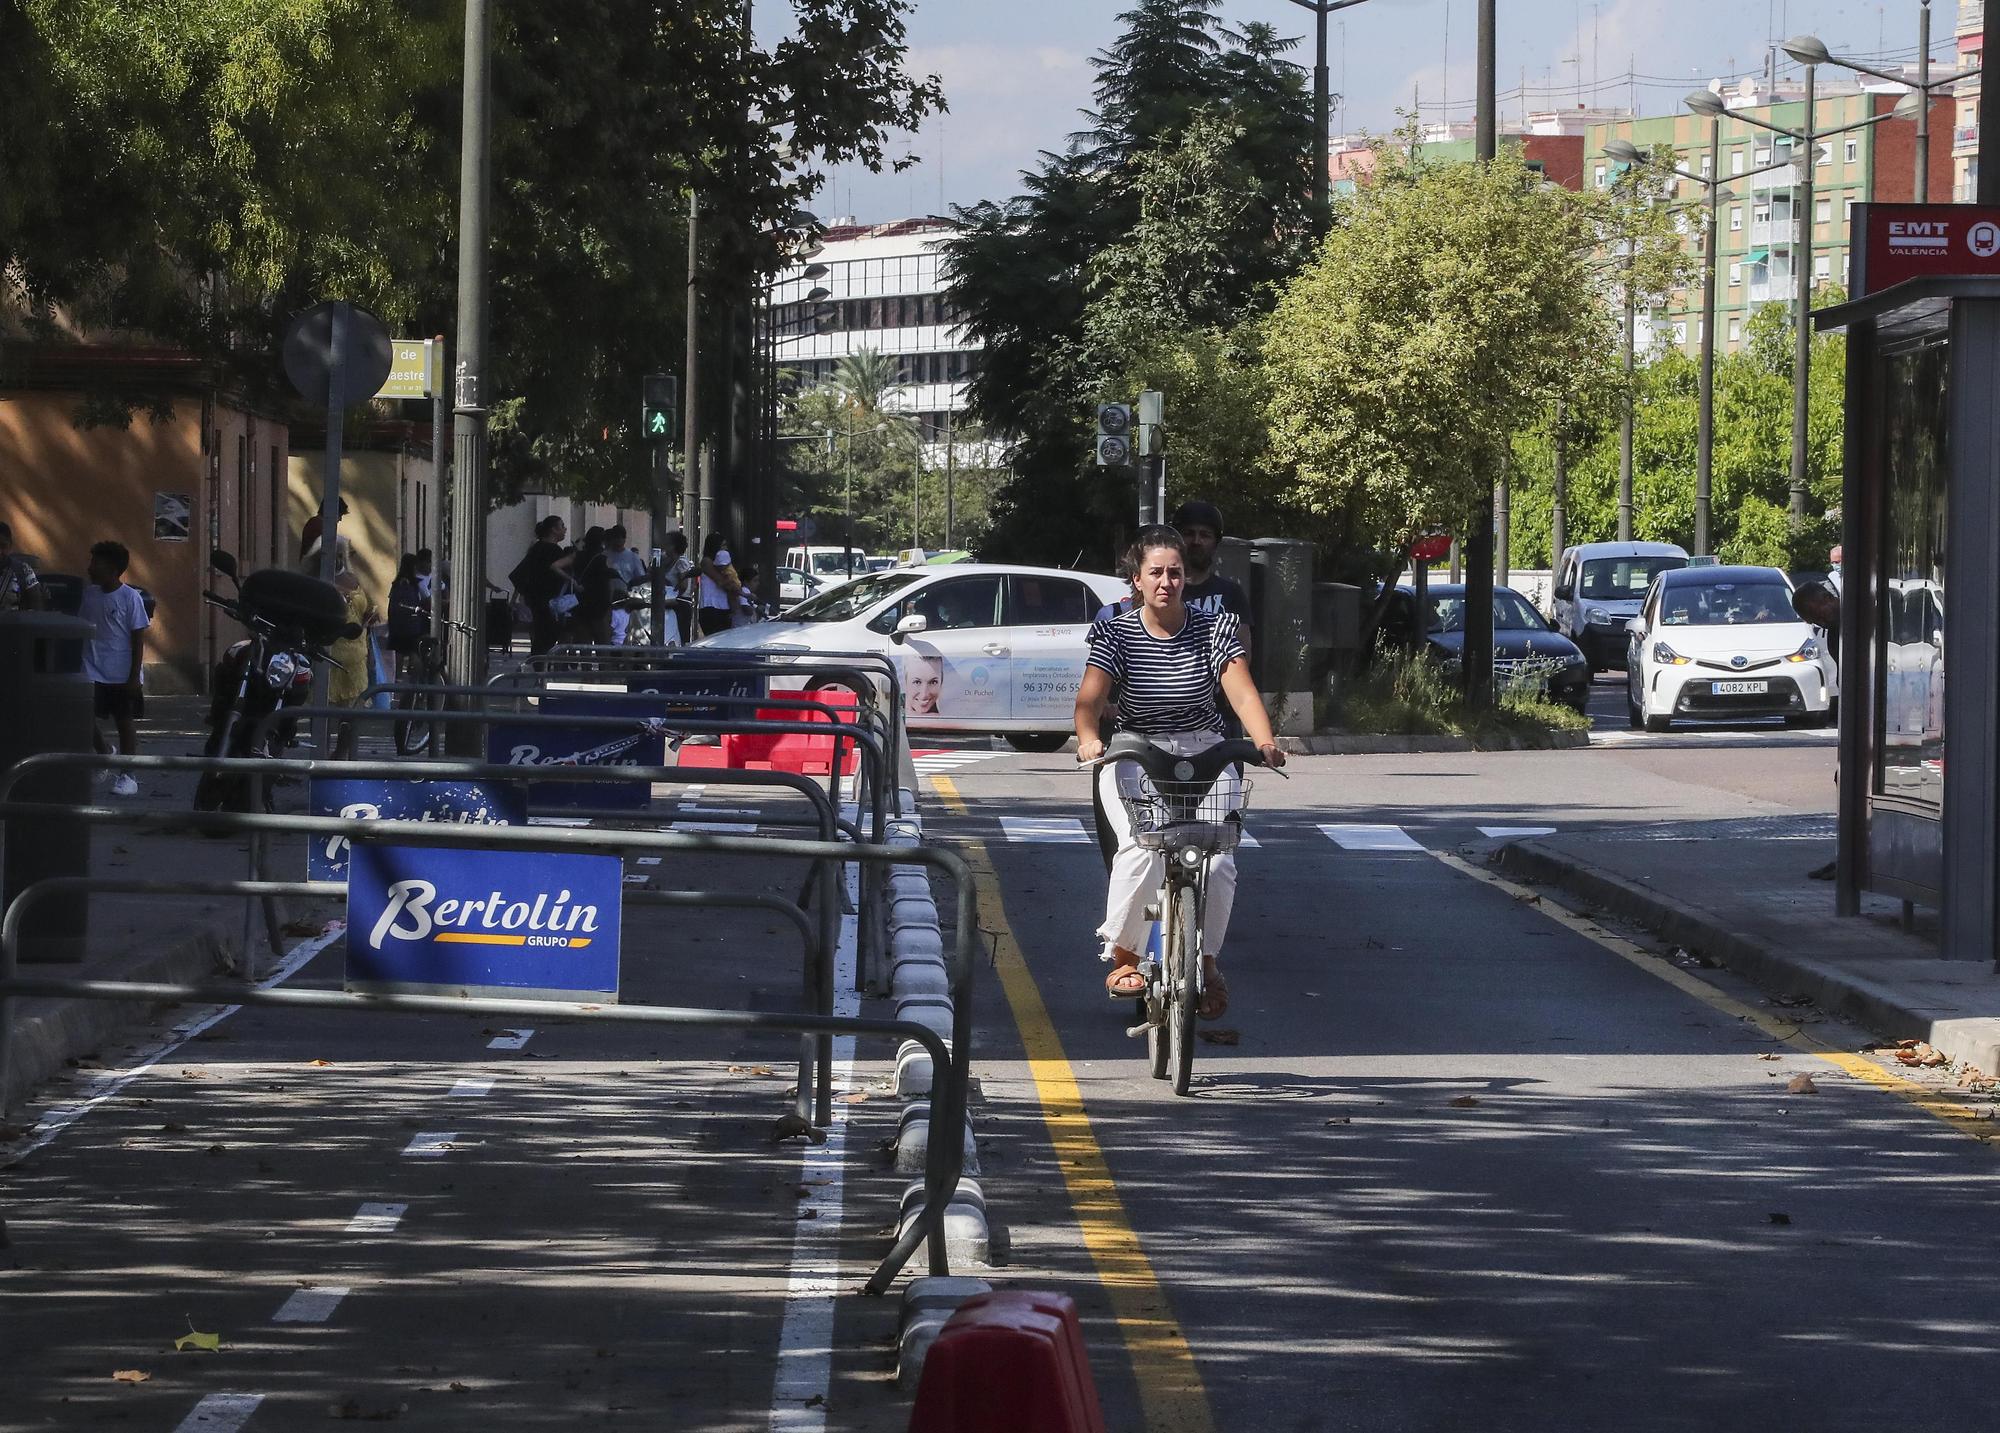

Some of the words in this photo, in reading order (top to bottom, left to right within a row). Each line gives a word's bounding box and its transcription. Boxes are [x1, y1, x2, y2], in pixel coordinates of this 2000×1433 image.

[1888, 222, 1949, 235] EMT
[400, 349, 417, 360] de
[388, 370, 425, 381] aestre
[1023, 682, 1035, 692] 96
[1037, 682, 1054, 692] 379
[1056, 682, 1067, 692] 66
[1069, 682, 1080, 692] 55
[1720, 683, 1744, 693] 4082
[1746, 682, 1765, 692] KPL
[527, 935, 568, 948] GRUPO
